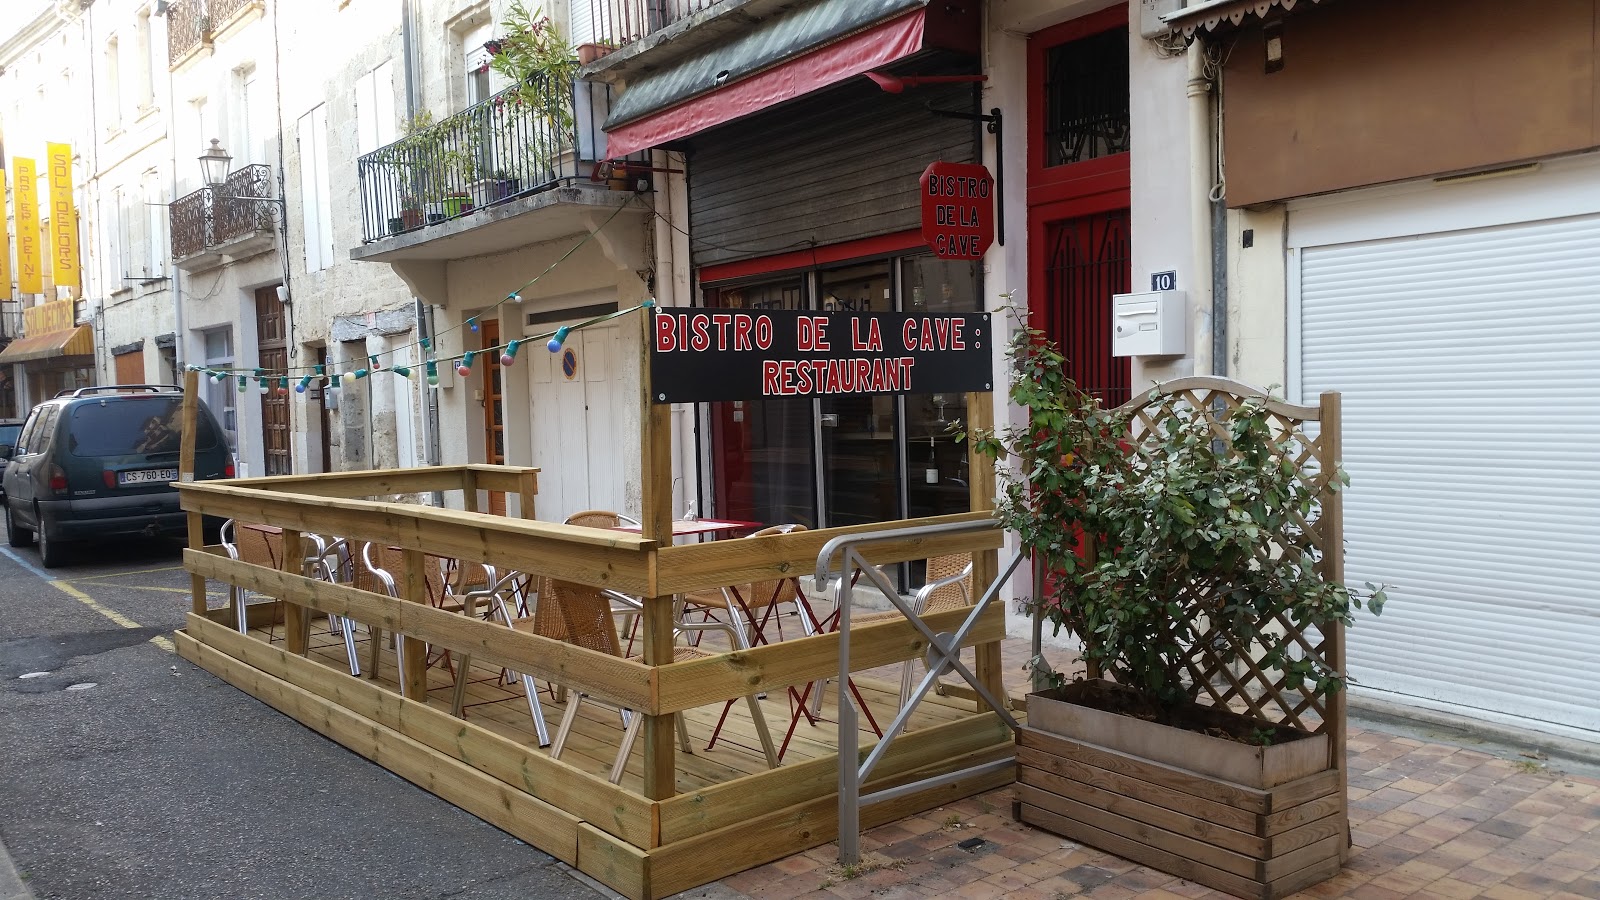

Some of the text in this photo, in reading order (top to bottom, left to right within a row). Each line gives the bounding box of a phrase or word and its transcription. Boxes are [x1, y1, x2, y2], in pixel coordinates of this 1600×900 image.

[928, 173, 989, 199] BISTRO
[19, 166, 34, 281] PAPIER PEINT
[54, 154, 72, 270] SOL DECORS
[936, 204, 980, 228] DE LA
[936, 233, 981, 257] CAVE
[1155, 274, 1171, 291] 10
[655, 313, 773, 352] BISTRO
[797, 316, 831, 352] DE
[851, 317, 884, 352] LA
[762, 357, 915, 396] RESTAURANT
